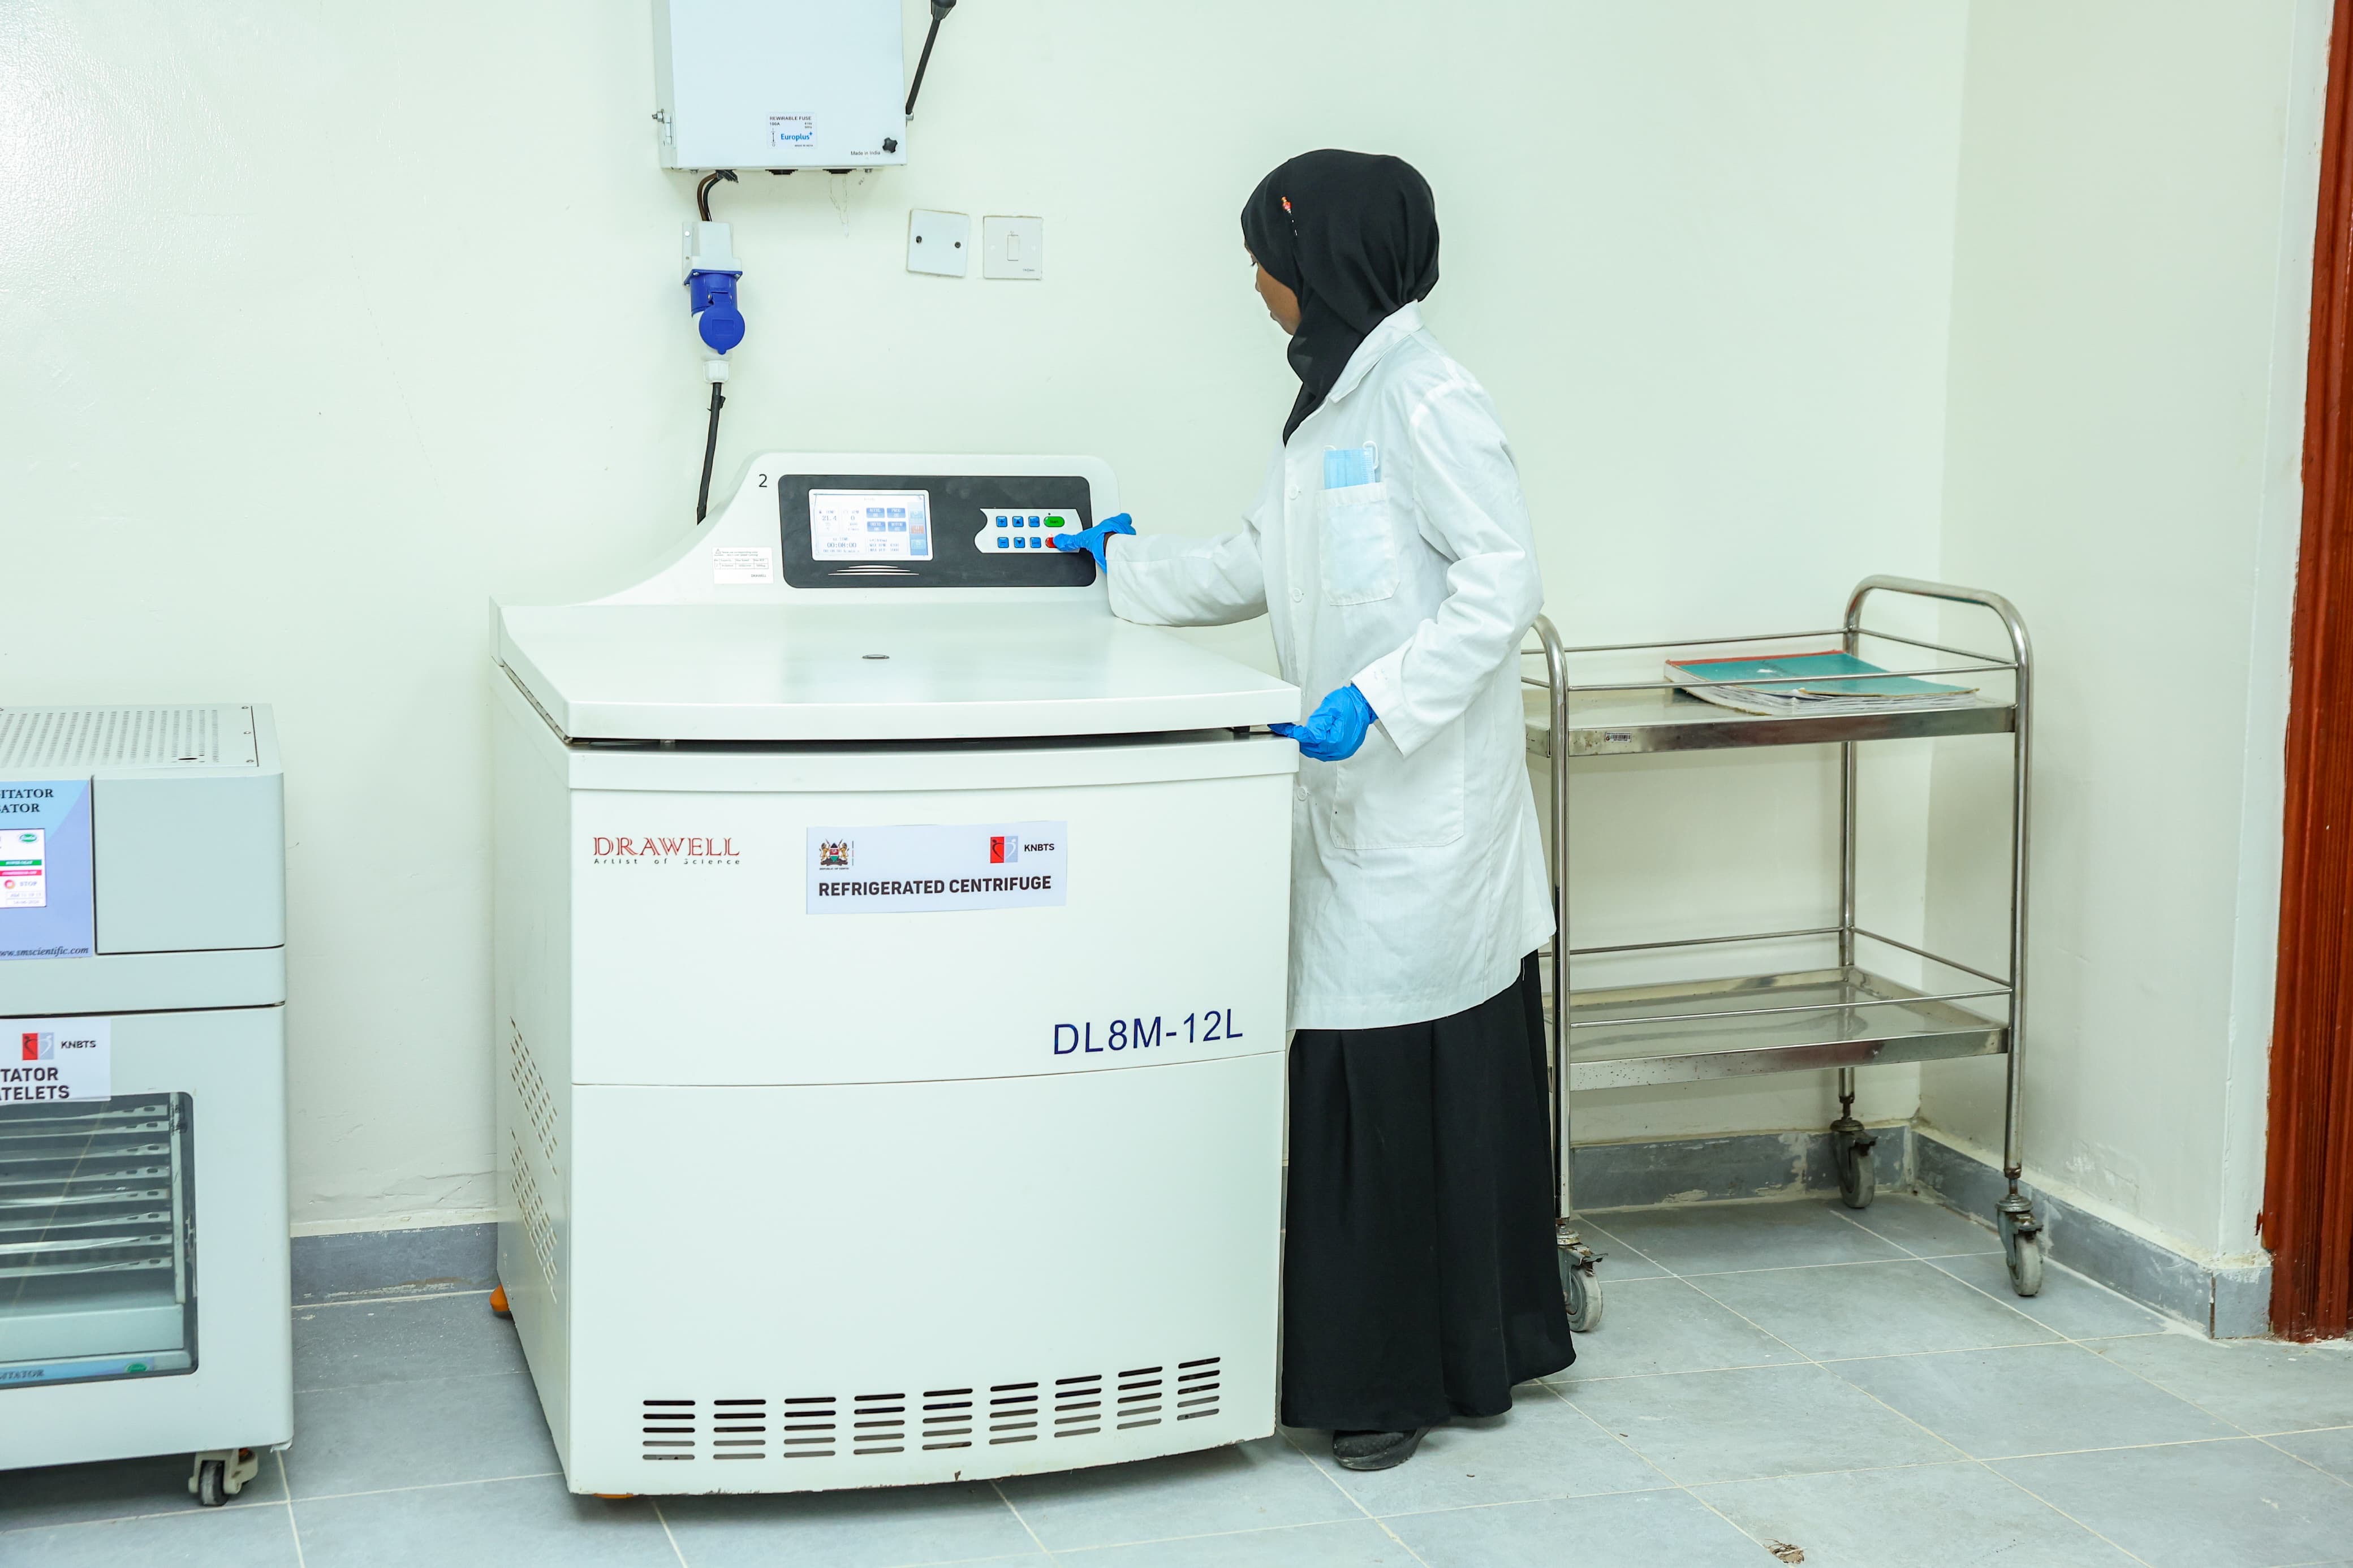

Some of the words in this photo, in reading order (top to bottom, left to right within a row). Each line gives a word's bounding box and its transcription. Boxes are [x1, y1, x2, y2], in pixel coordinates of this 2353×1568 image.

[759, 473, 768, 487] 2
[0, 788, 54, 798] ITATOR
[0, 803, 40, 813] ATOR
[593, 837, 740, 856] DRAWELL
[1024, 843, 1055, 852] KNBTS
[818, 879, 945, 896] REFRIGERATED
[949, 875, 1051, 893] CENTRIFUGE
[1054, 1008, 1243, 1055] DL8M-12L
[61, 1040, 97, 1049] KNBTS
